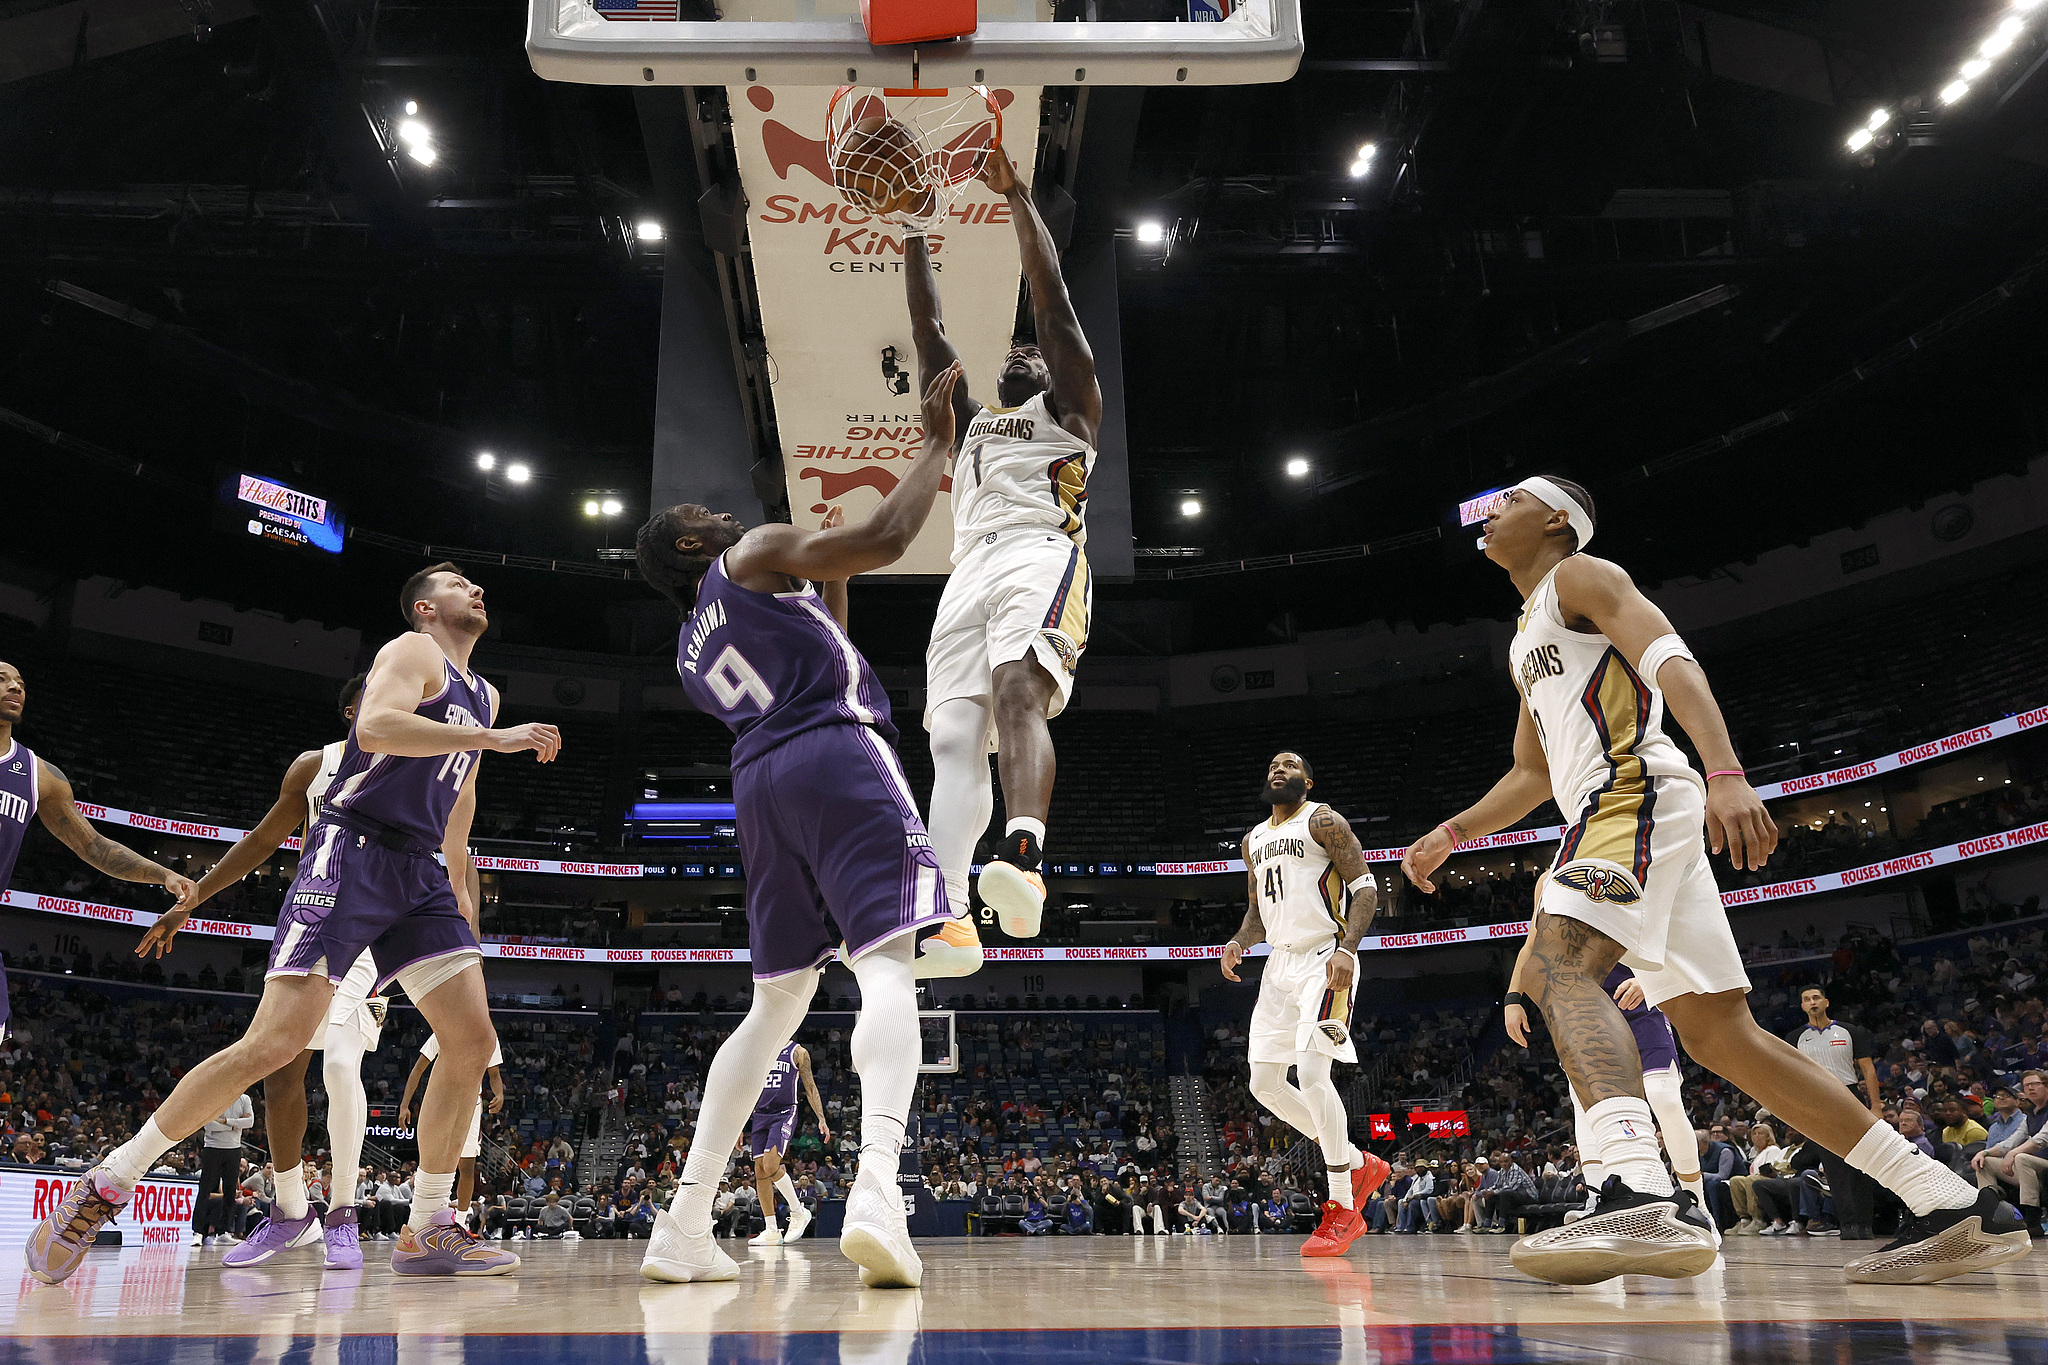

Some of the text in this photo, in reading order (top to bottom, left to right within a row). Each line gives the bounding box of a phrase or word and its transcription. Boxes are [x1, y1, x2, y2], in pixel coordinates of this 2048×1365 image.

[1195, 10, 1215, 22] NBA
[760, 195, 1012, 224] SMOHIE
[829, 262, 942, 272] CENTR
[846, 414, 922, 422] ENTER
[969, 418, 1034, 441] ORLEANS
[971, 443, 984, 488] 1
[244, 480, 319, 519] Hustle STATS
[264, 524, 308, 544] CAESARS
[684, 598, 728, 674] ACHIUWA
[702, 643, 775, 714] 9
[2016, 707, 2048, 729] ROUS
[1898, 726, 1993, 766] ROUSES MARKETS
[1781, 762, 1877, 794] ROUSES MARKETS
[129, 813, 219, 838] ROUSES MARKETS
[1492, 830, 1538, 846] MARKETS
[1958, 823, 2048, 857] ROUSES MARKE
[1264, 838, 1305, 860] ORLEANS
[1363, 850, 1387, 861] USES
[496, 858, 539, 871] MARKETS
[560, 862, 640, 876] ROUSES MARKETS
[644, 866, 665, 874] FOULS
[671, 866, 677, 874] 0
[709, 866, 715, 874] 6
[1053, 865, 1062, 874] 11
[1088, 866, 1094, 874] 6
[1127, 865, 1133, 873] 0
[1157, 861, 1229, 874] OUSES MARKETS
[1841, 852, 1934, 885] ROUSES MARKETS
[1265, 864, 1283, 904] 41
[1763, 879, 1817, 898] MARKETS
[37, 896, 134, 922] ROUSES MARKETS
[292, 893, 336, 908] KINGS
[201, 920, 252, 936] MARKETS
[1489, 922, 1529, 937] ROUSES
[53, 933, 80, 955] 116
[1380, 929, 1467, 948] ROUSES MARKETS
[500, 945, 585, 960] ROUSES MARKETS
[607, 949, 734, 961] ROUSES ROUSES MARKETS
[983, 948, 1045, 960] SES MARKETS
[1065, 948, 1148, 959] ROUSES MARKETS
[1168, 947, 1204, 958] ROUSES
[1022, 975, 1044, 993] 119
[764, 1073, 782, 1089] 22
[365, 1124, 415, 1140] ntergy
[133, 1185, 192, 1223] ROUSES
[142, 1227, 180, 1243] MARKETS
